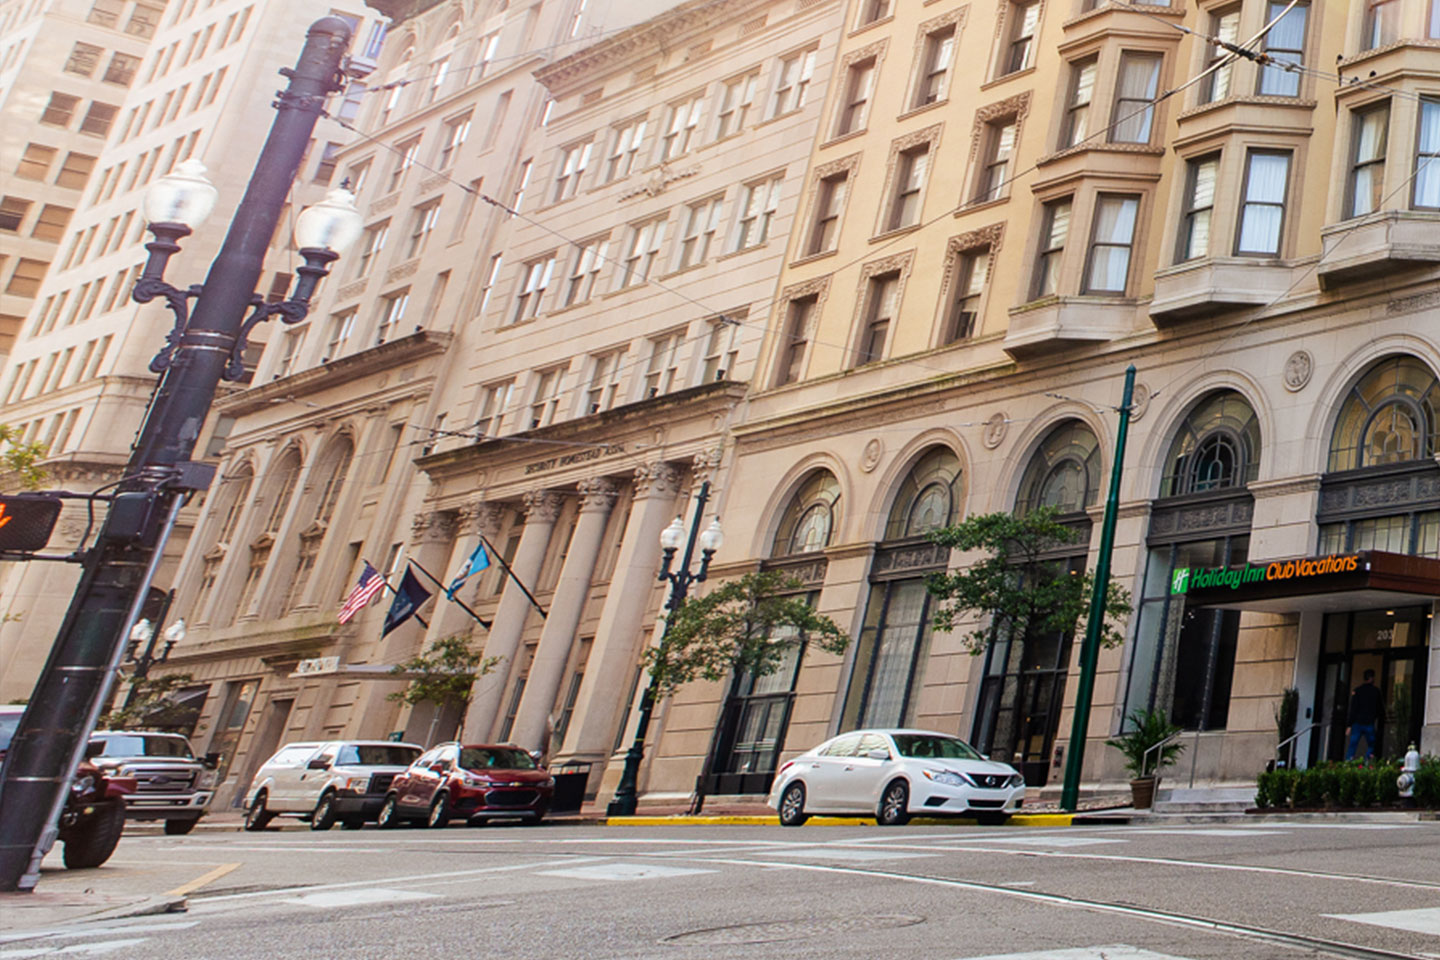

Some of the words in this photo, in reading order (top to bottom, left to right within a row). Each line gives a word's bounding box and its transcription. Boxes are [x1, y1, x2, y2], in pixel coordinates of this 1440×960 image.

[1190, 565, 1243, 589] Holiday
[1242, 562, 1265, 583] Inn
[1266, 561, 1295, 581] Club
[1295, 554, 1358, 577] Vacations
